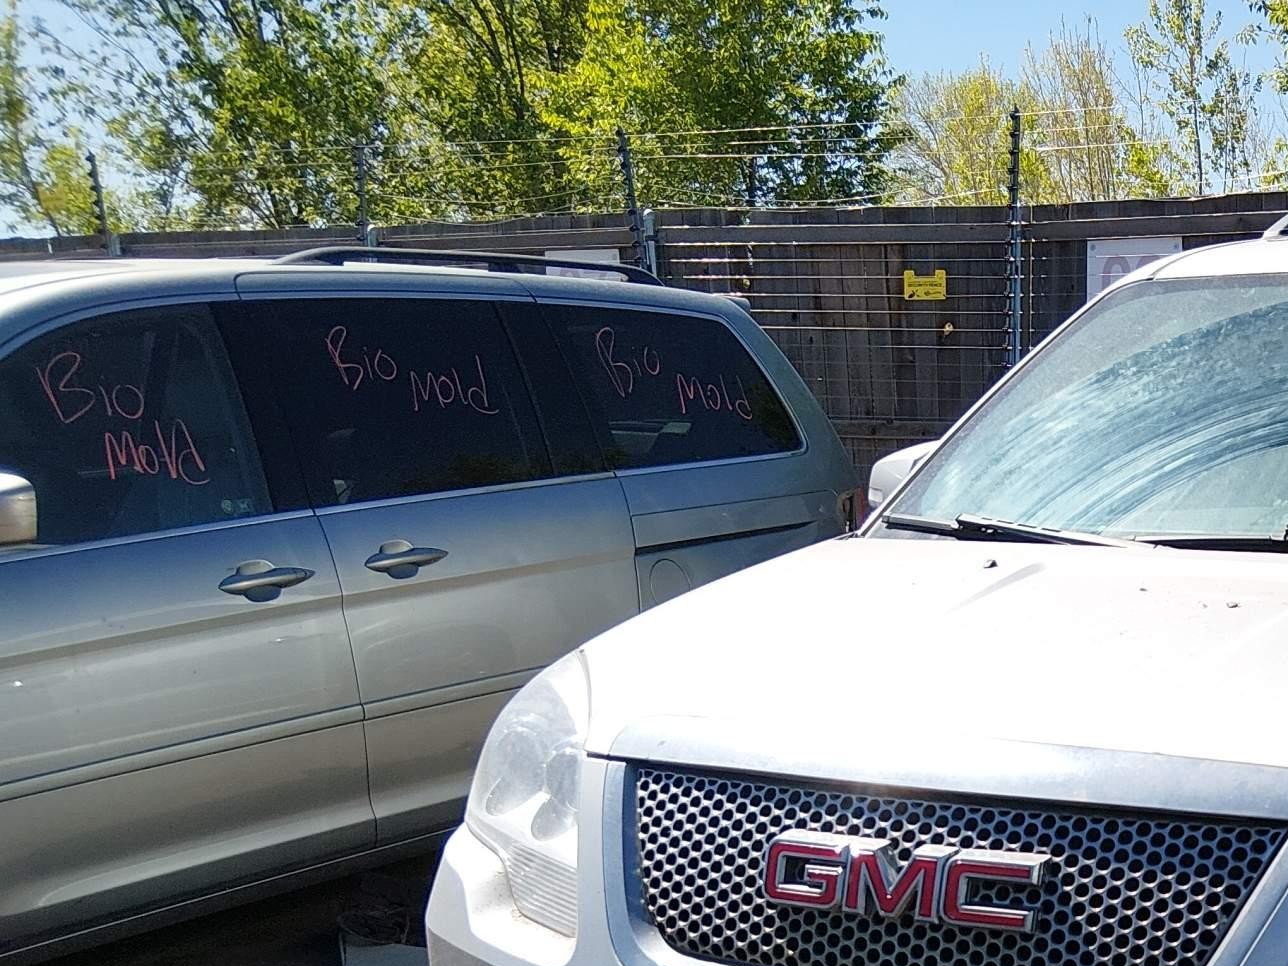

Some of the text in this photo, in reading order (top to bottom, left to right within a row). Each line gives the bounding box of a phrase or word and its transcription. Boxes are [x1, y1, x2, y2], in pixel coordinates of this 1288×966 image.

[35, 351, 145, 424] Bio
[323, 325, 500, 415] Bio Mold
[595, 326, 753, 420] Bio Mold
[104, 418, 210, 485] Mold
[763, 829, 1050, 932] GMC
